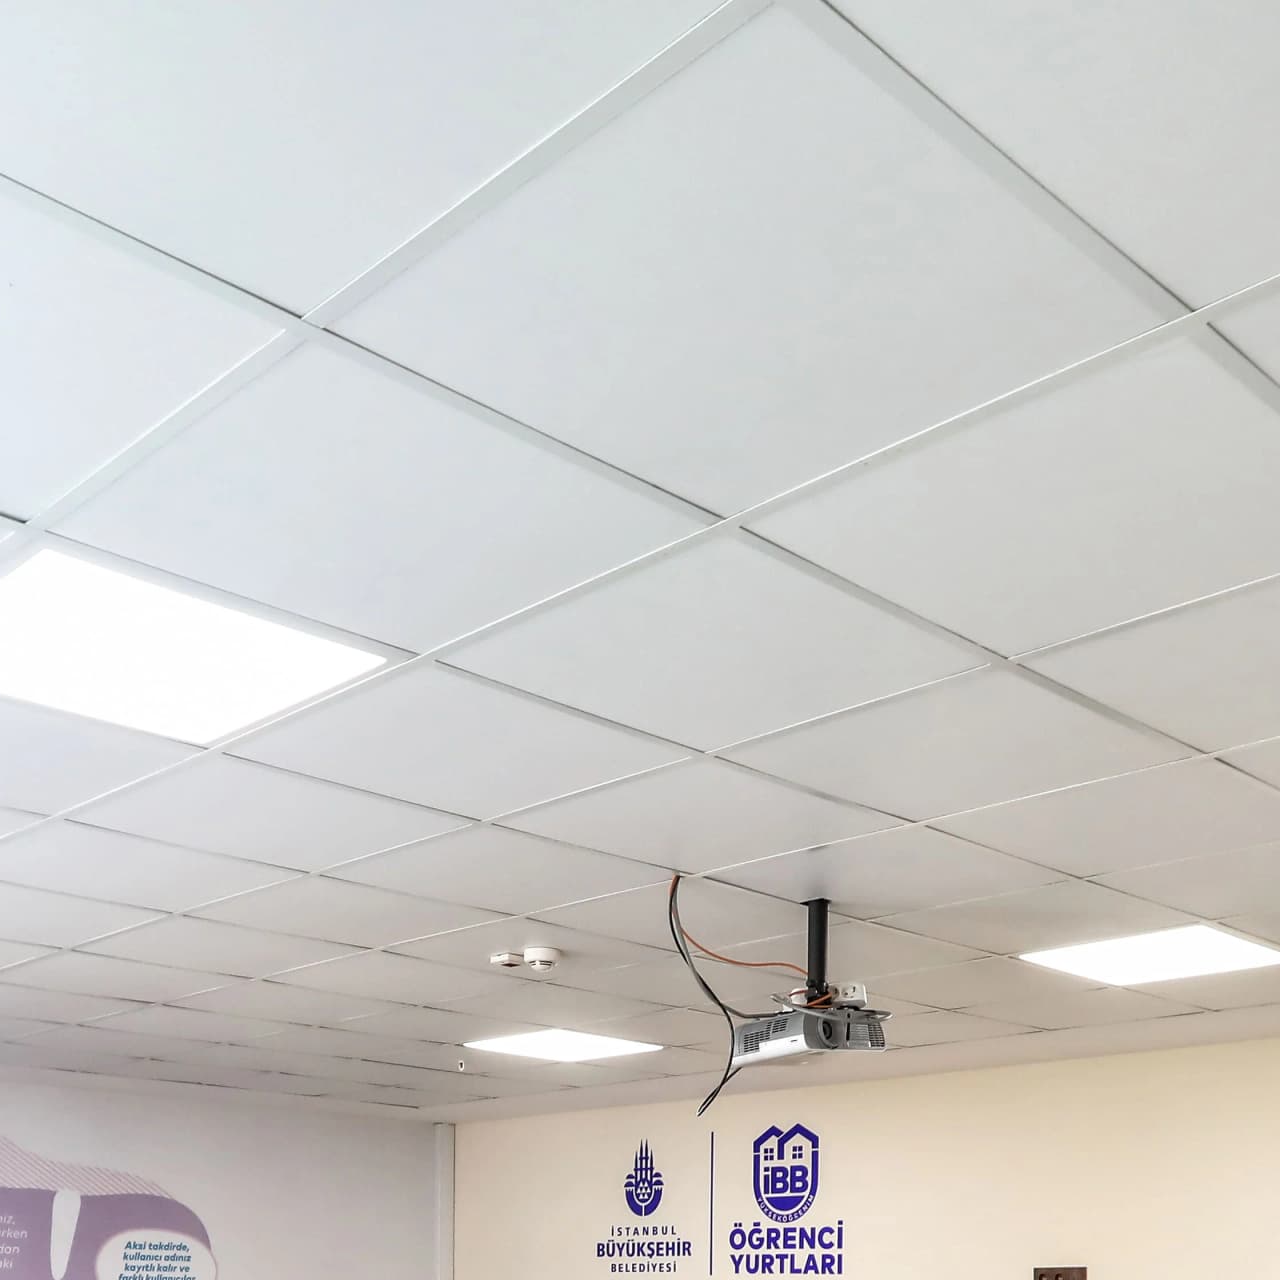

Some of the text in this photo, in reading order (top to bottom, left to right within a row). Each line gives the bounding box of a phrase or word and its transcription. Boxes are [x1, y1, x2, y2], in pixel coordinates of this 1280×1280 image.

[611, 1225, 677, 1236] İSTANBUL
[729, 1220, 844, 1250] ÖĞRENCİ
[125, 1241, 146, 1250] Aksi
[596, 1237, 692, 1259] BÜYÜKŞEHİR
[123, 1252, 192, 1262] kullanıcı adınız
[124, 1263, 156, 1273] kayıtlı
[157, 1264, 178, 1272] kalır
[611, 1262, 677, 1273] BELEDİYESİ
[729, 1253, 844, 1275] YURTLARI
